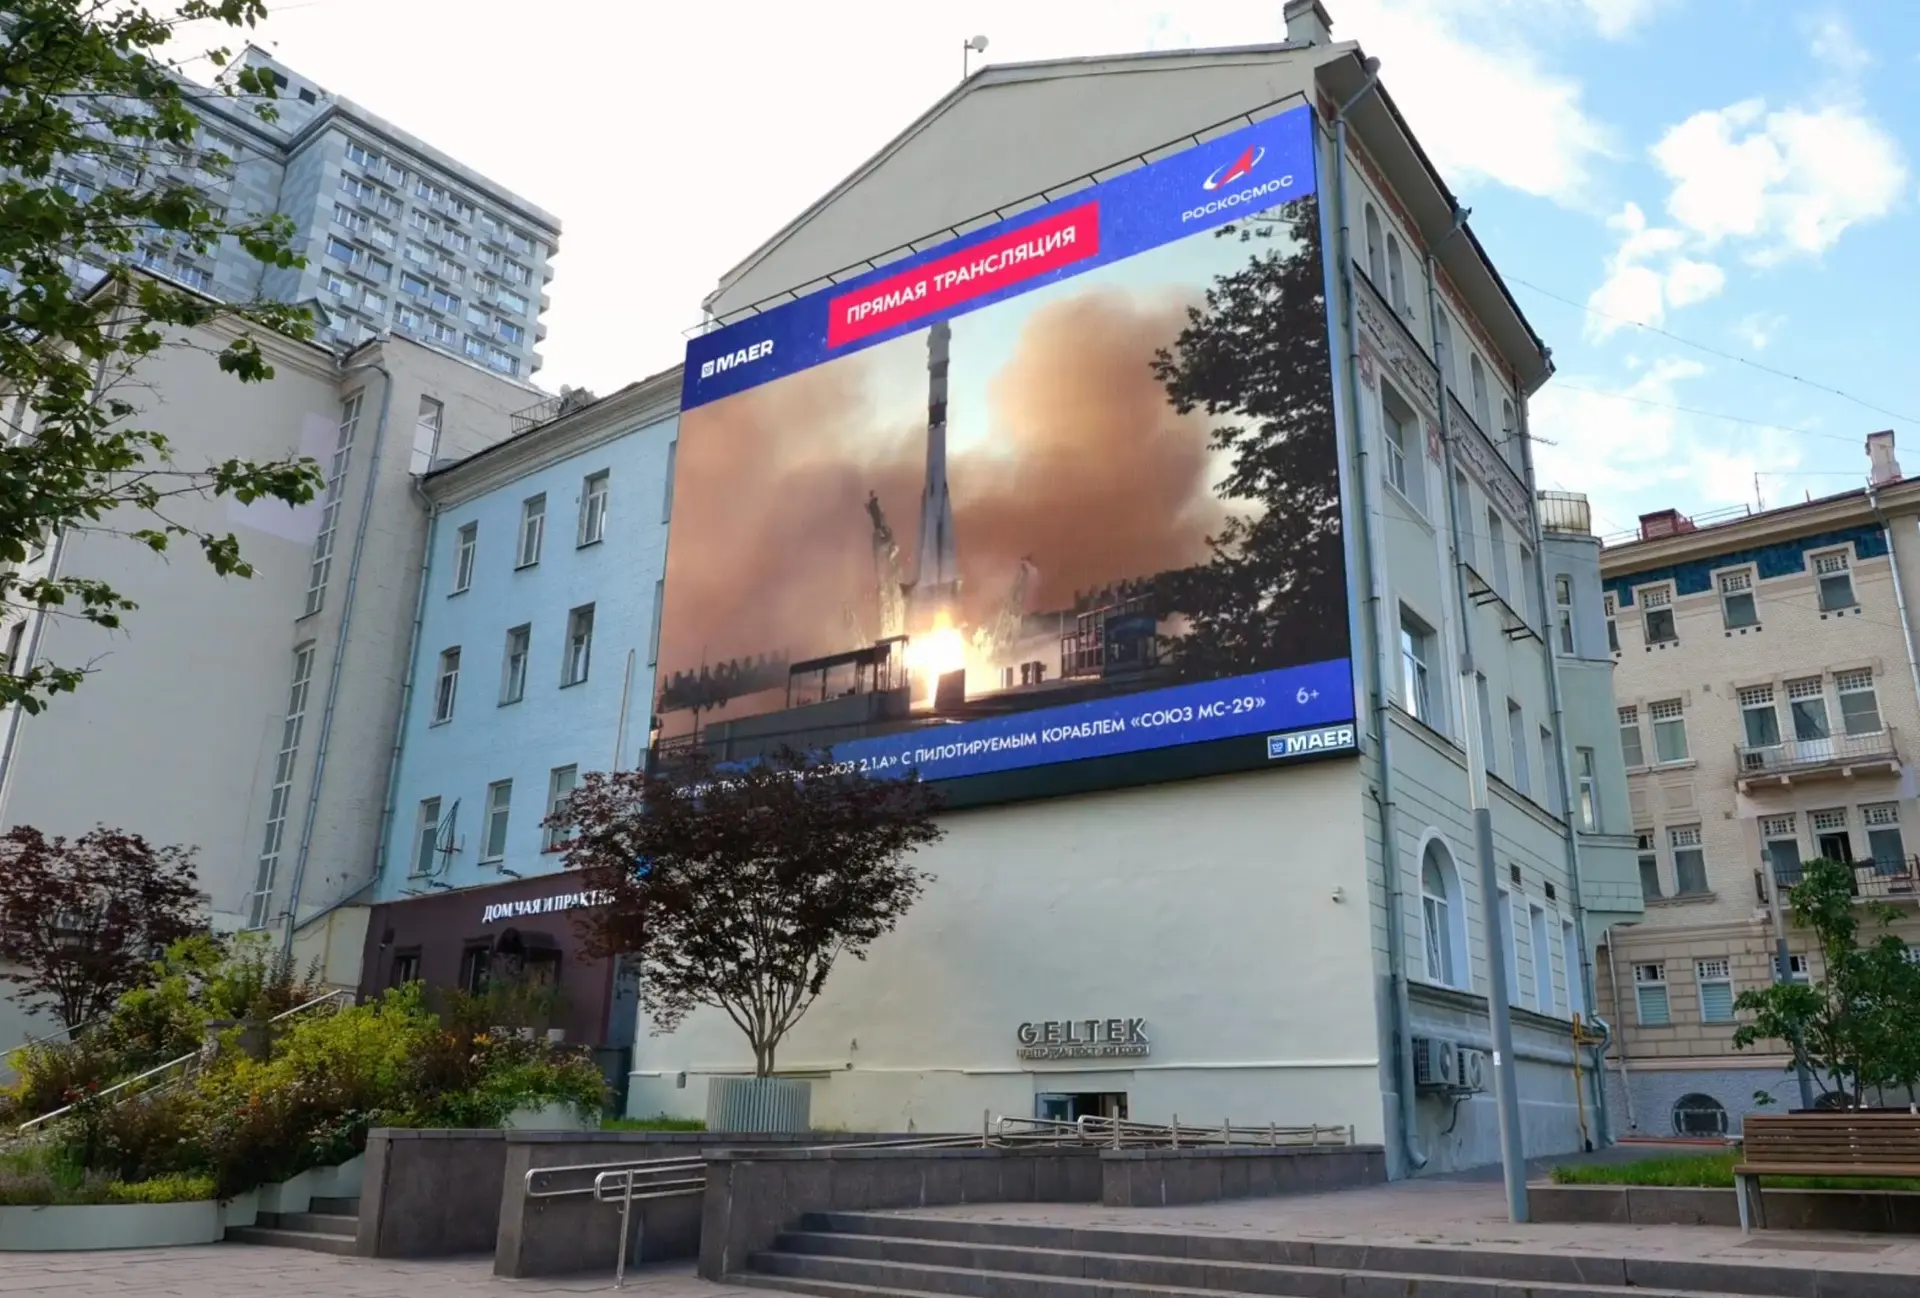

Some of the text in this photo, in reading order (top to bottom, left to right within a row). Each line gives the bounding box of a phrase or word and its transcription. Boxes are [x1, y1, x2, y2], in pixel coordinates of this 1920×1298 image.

[1181, 174, 1294, 224] РОСКОСМОС
[846, 225, 1077, 325] ПРЯМАЯ ТРАНСЛЯЦИЯ
[716, 339, 775, 374] MAER
[1296, 686, 1321, 705] 6+
[901, 751, 911, 765] С
[915, 732, 1037, 763] ПИЛОТИРУЕМЫМ
[1041, 717, 1126, 744] КОРАБЛЕМ
[1130, 706, 1193, 728] «СОЮЗ
[1197, 695, 1267, 720] МС-29»
[1287, 729, 1353, 753] MAER
[482, 903, 513, 923] ДОМ
[514, 898, 541, 916] ЧАЯ
[543, 897, 552, 911] И
[1017, 1017, 1149, 1047] GELTEK
